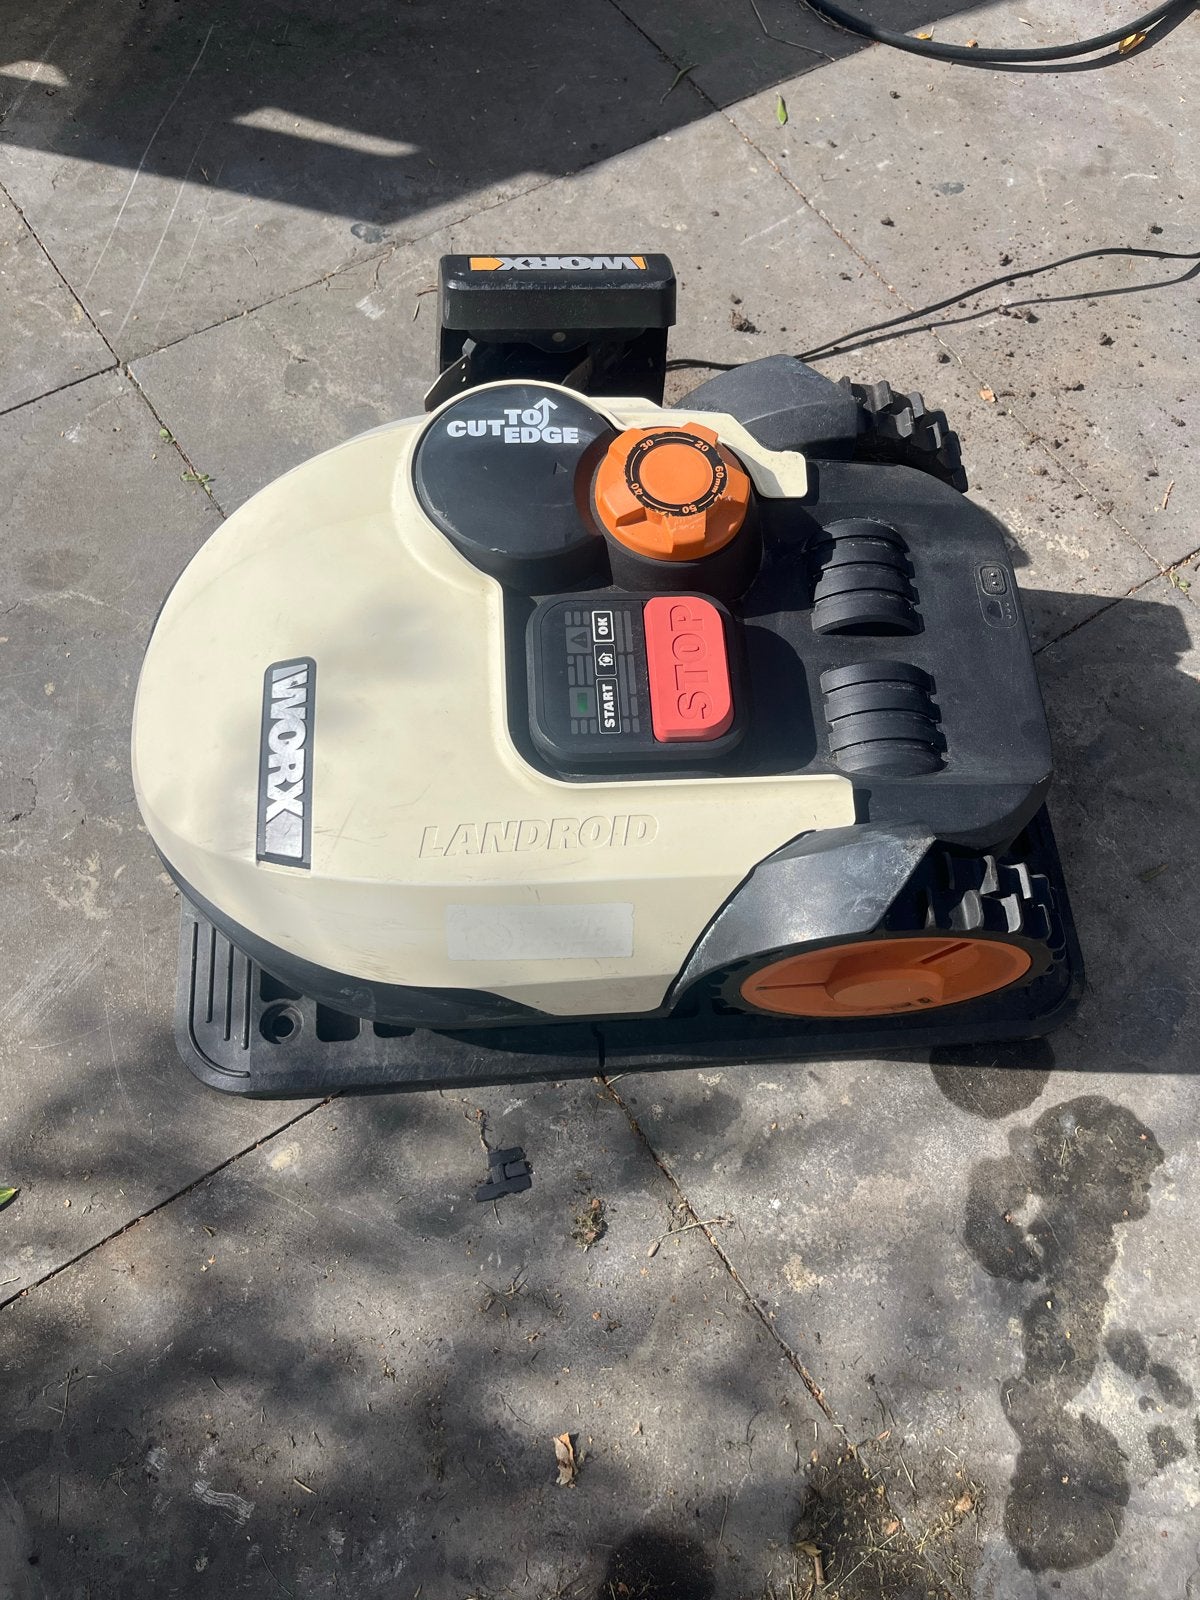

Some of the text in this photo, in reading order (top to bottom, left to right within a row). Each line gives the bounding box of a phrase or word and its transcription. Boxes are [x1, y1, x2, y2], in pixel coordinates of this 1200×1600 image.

[499, 256, 638, 271] WORX
[446, 409, 579, 444] CUT TO EDGE
[639, 439, 654, 451] 30
[694, 440, 709, 452] 20
[630, 483, 644, 496] 40
[681, 504, 698, 514] 50
[597, 616, 609, 635] OK
[669, 604, 713, 720] STOP
[601, 683, 616, 728] START
[265, 669, 308, 824] WORX
[418, 814, 659, 859] LANDROID
